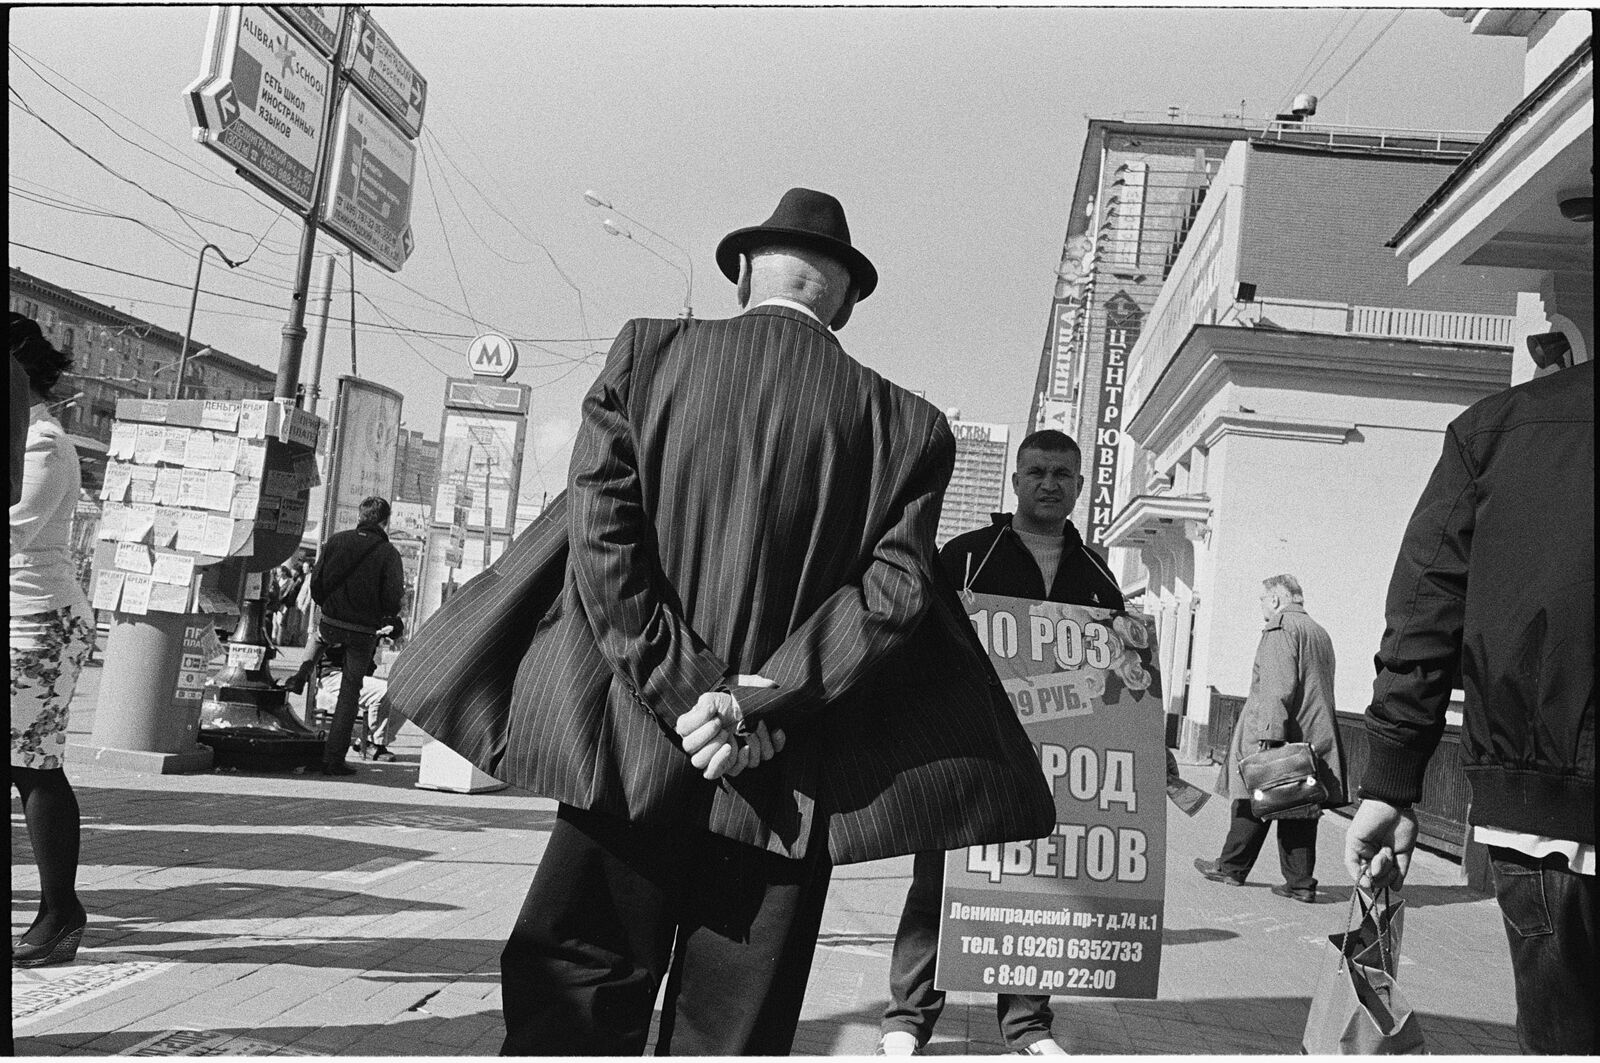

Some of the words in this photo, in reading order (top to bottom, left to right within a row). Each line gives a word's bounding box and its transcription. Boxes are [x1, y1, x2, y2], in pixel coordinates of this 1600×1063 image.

[243, 17, 274, 53] ALIBRA
[295, 62, 325, 97] SCHOOL
[264, 71, 282, 95] СЕТЬ
[284, 87, 306, 113] ШКОЛ
[259, 105, 292, 139] ЯЗЫКОВ
[261, 88, 316, 140] ИНОСТРАННЫХ
[1054, 309, 1077, 397] ПИЦЦА
[1104, 328, 1128, 424] ЦЕНТР
[204, 400, 240, 413] ДЕНЬГИ
[949, 421, 992, 443] ОСКВЫ
[969, 609, 1019, 660] 10
[1030, 614, 1112, 670] РОЗ
[1036, 683, 1088, 715] РУБ.
[1031, 741, 1139, 814] РОД
[966, 821, 1149, 884] ЦВЕТОВ
[949, 901, 1071, 927] Ленинградский
[1072, 912, 1105, 929] пр-т
[1105, 911, 1137, 931] д.74
[1138, 913, 1158, 931] к.1
[960, 934, 999, 955] тел.
[1001, 934, 1015, 957] 8
[1016, 935, 1065, 959] (926)
[1066, 937, 1144, 963] 6352733
[982, 966, 996, 985] с
[997, 963, 1038, 987] 8:00
[1038, 968, 1065, 990] до
[1066, 967, 1117, 990] 22:00
